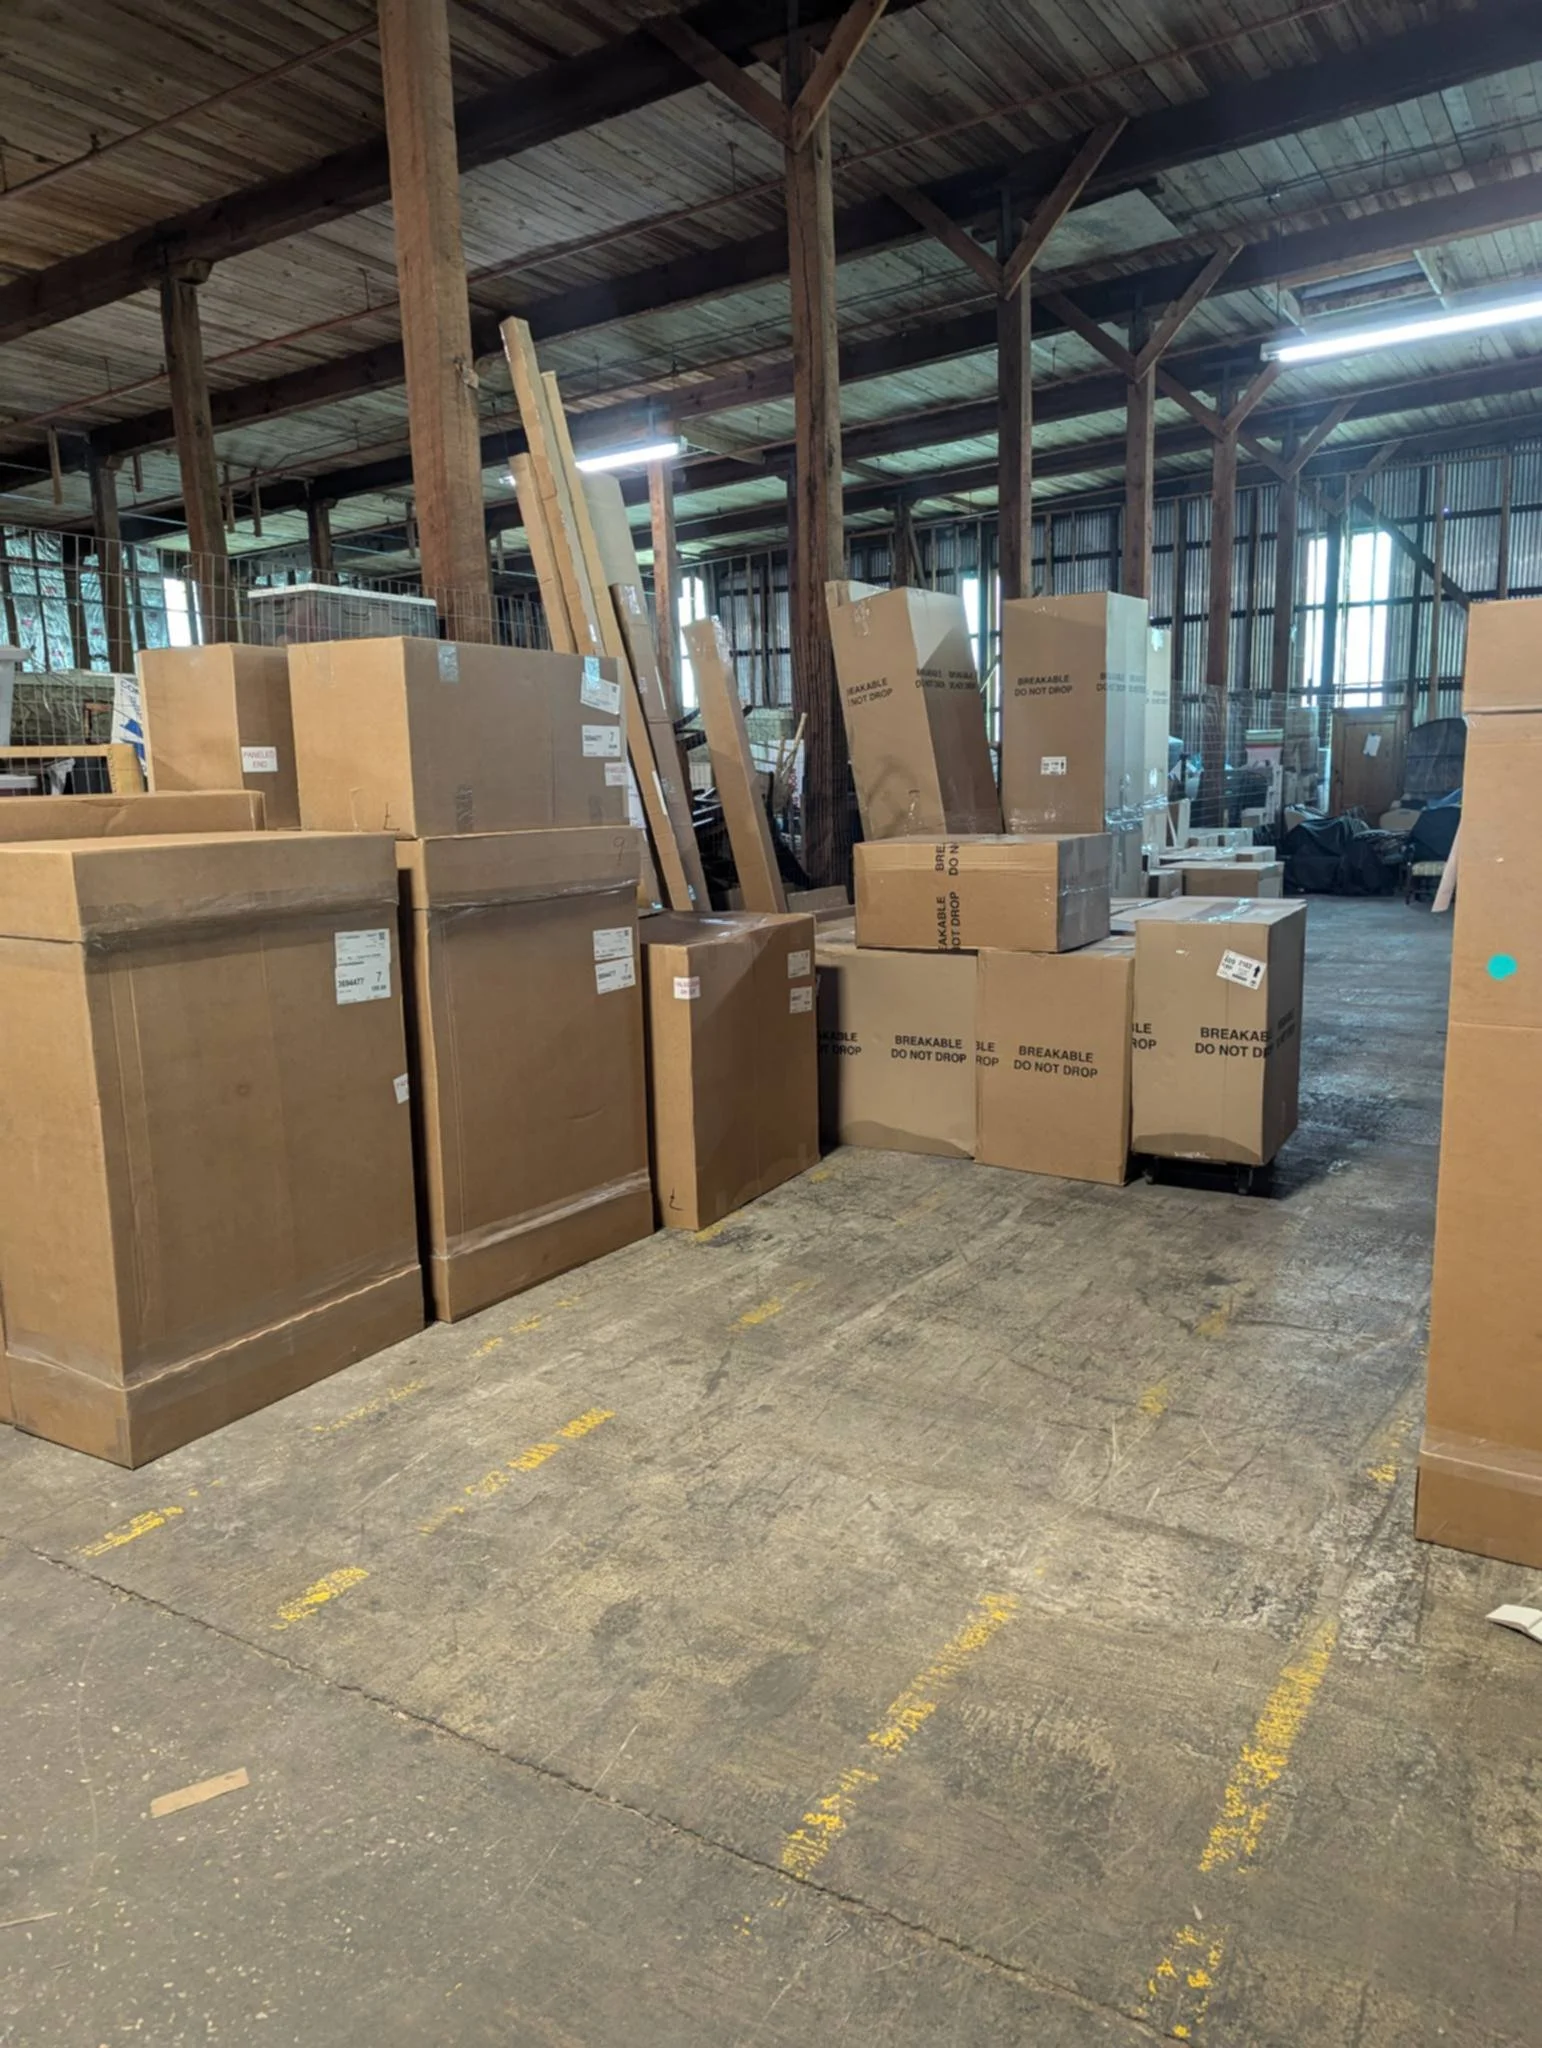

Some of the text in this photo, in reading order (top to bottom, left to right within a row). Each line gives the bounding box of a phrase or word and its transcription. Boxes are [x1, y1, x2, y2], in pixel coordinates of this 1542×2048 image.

[1017, 675, 1070, 685] BREAKABLE
[869, 688, 893, 701] DROP
[1014, 685, 1073, 697] DO NOT DROP
[948, 857, 959, 876] DO
[950, 891, 961, 927] DROP
[895, 1035, 963, 1049] BREAKABLE
[1194, 1042, 1215, 1055] DO
[1219, 1045, 1246, 1057] NOT
[832, 1044, 862, 1056] DROP
[891, 1048, 967, 1064] DO NOT DROP
[1019, 1045, 1094, 1063] BREAKABLE
[1013, 1059, 1098, 1079] DO NOT DROP
